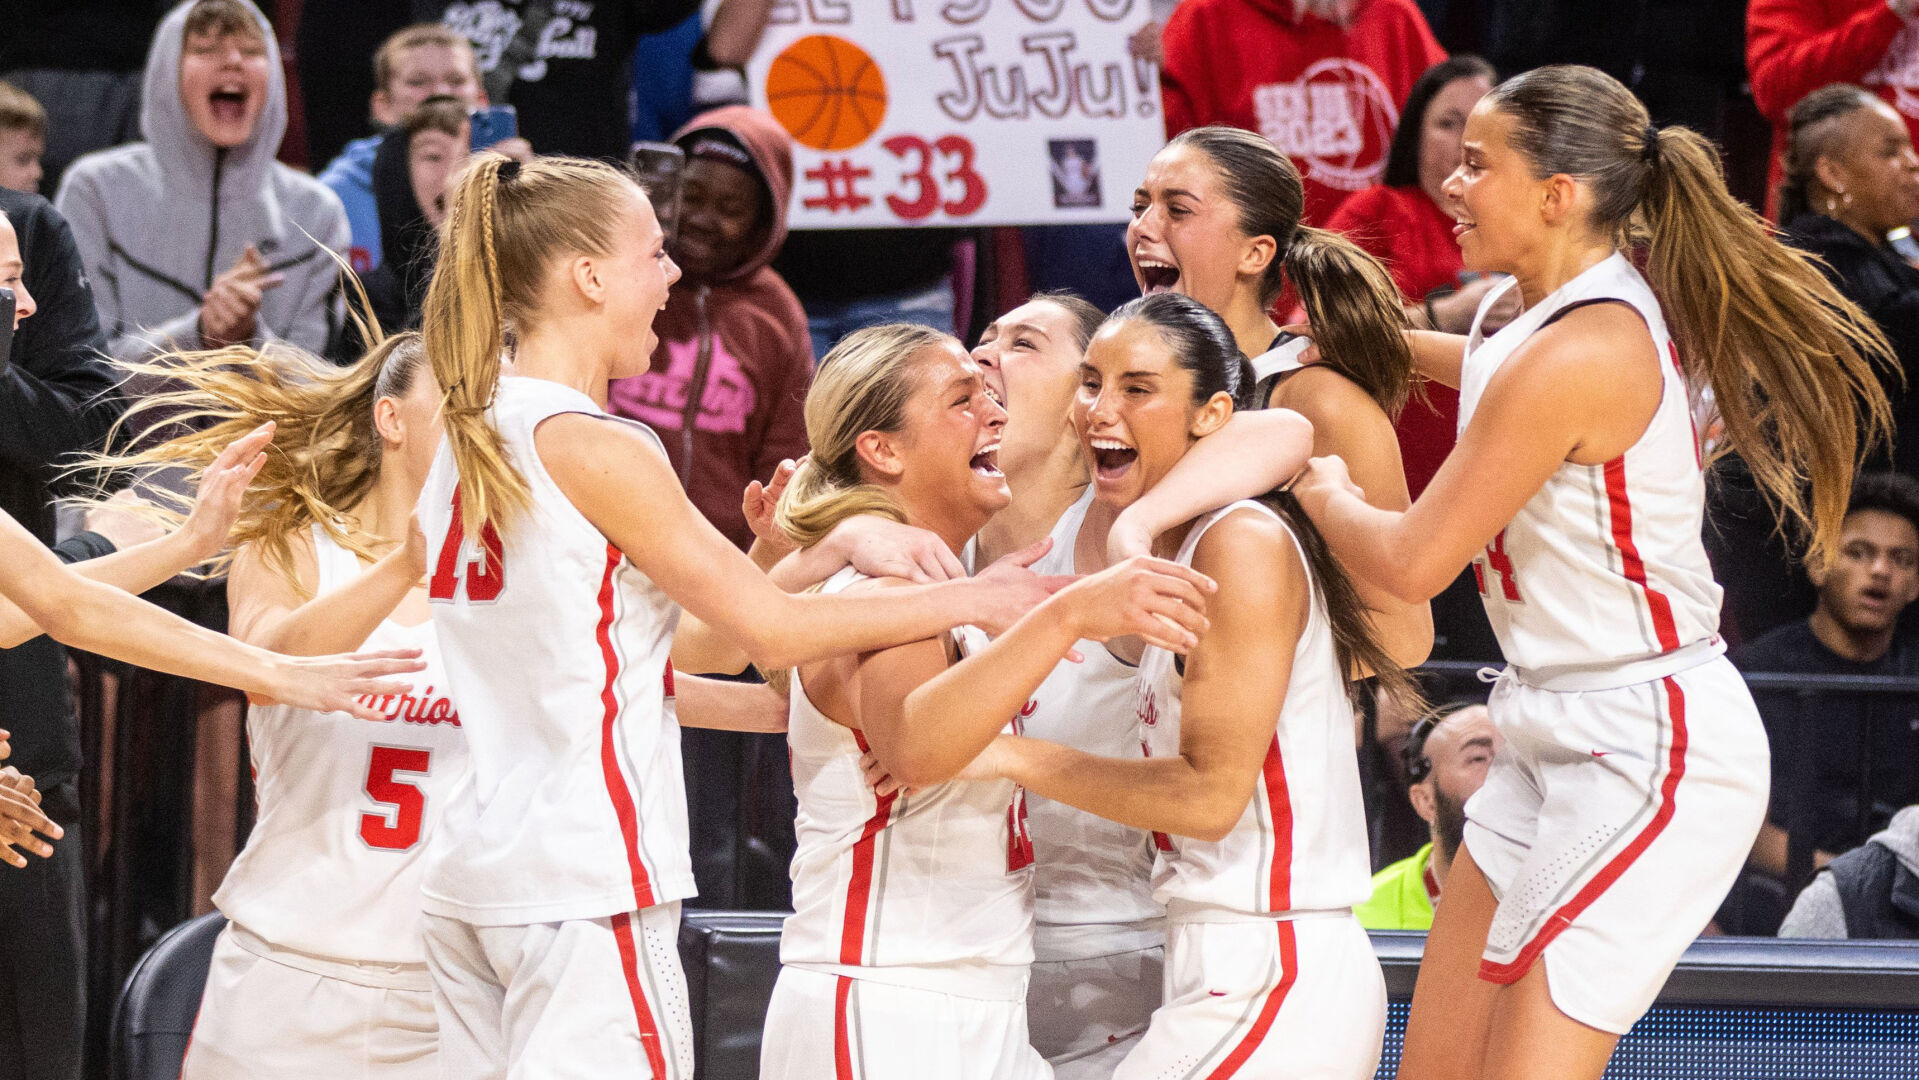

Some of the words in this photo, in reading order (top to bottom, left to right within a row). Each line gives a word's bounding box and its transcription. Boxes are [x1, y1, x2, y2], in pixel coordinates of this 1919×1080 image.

[932, 31, 1158, 122] JuJu!
[803, 133, 988, 220] #33
[1473, 527, 1526, 604] 4
[356, 742, 434, 853] 5
